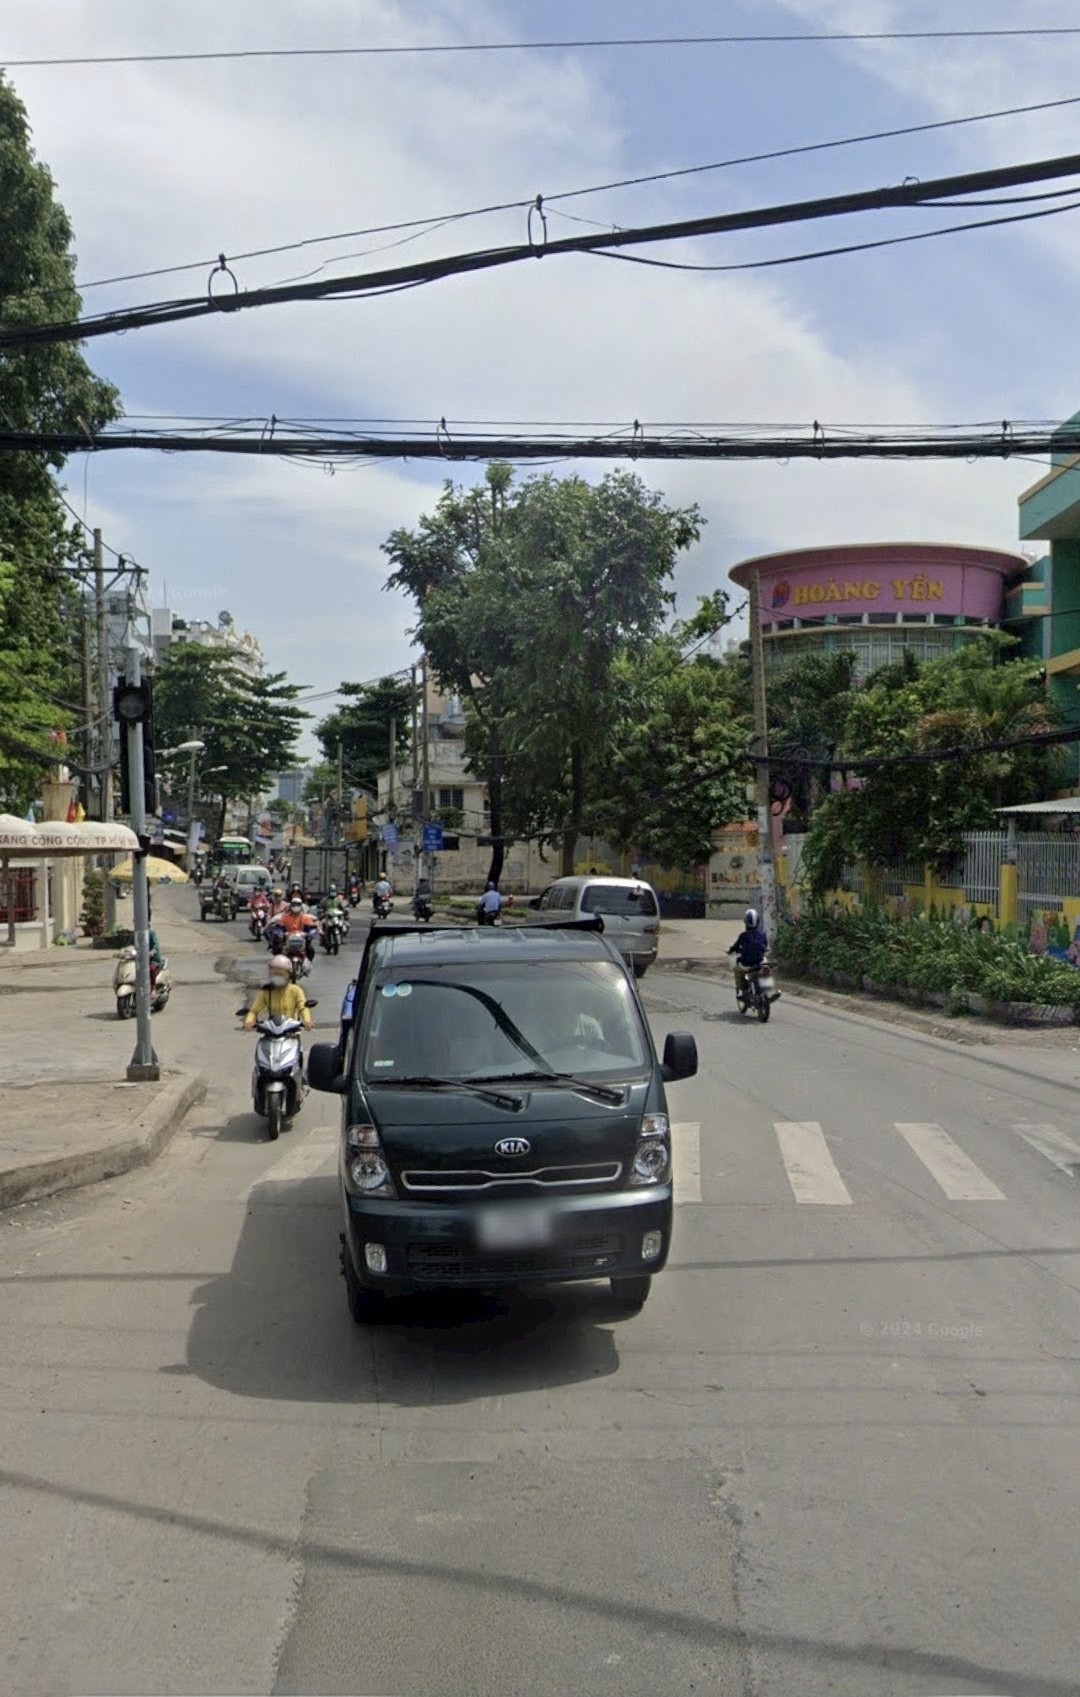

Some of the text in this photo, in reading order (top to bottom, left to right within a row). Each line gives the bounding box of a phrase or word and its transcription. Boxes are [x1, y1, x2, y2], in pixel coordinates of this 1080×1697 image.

[793, 573, 944, 606] HOÀNG YẾN
[499, 1141, 526, 1154] KIA
